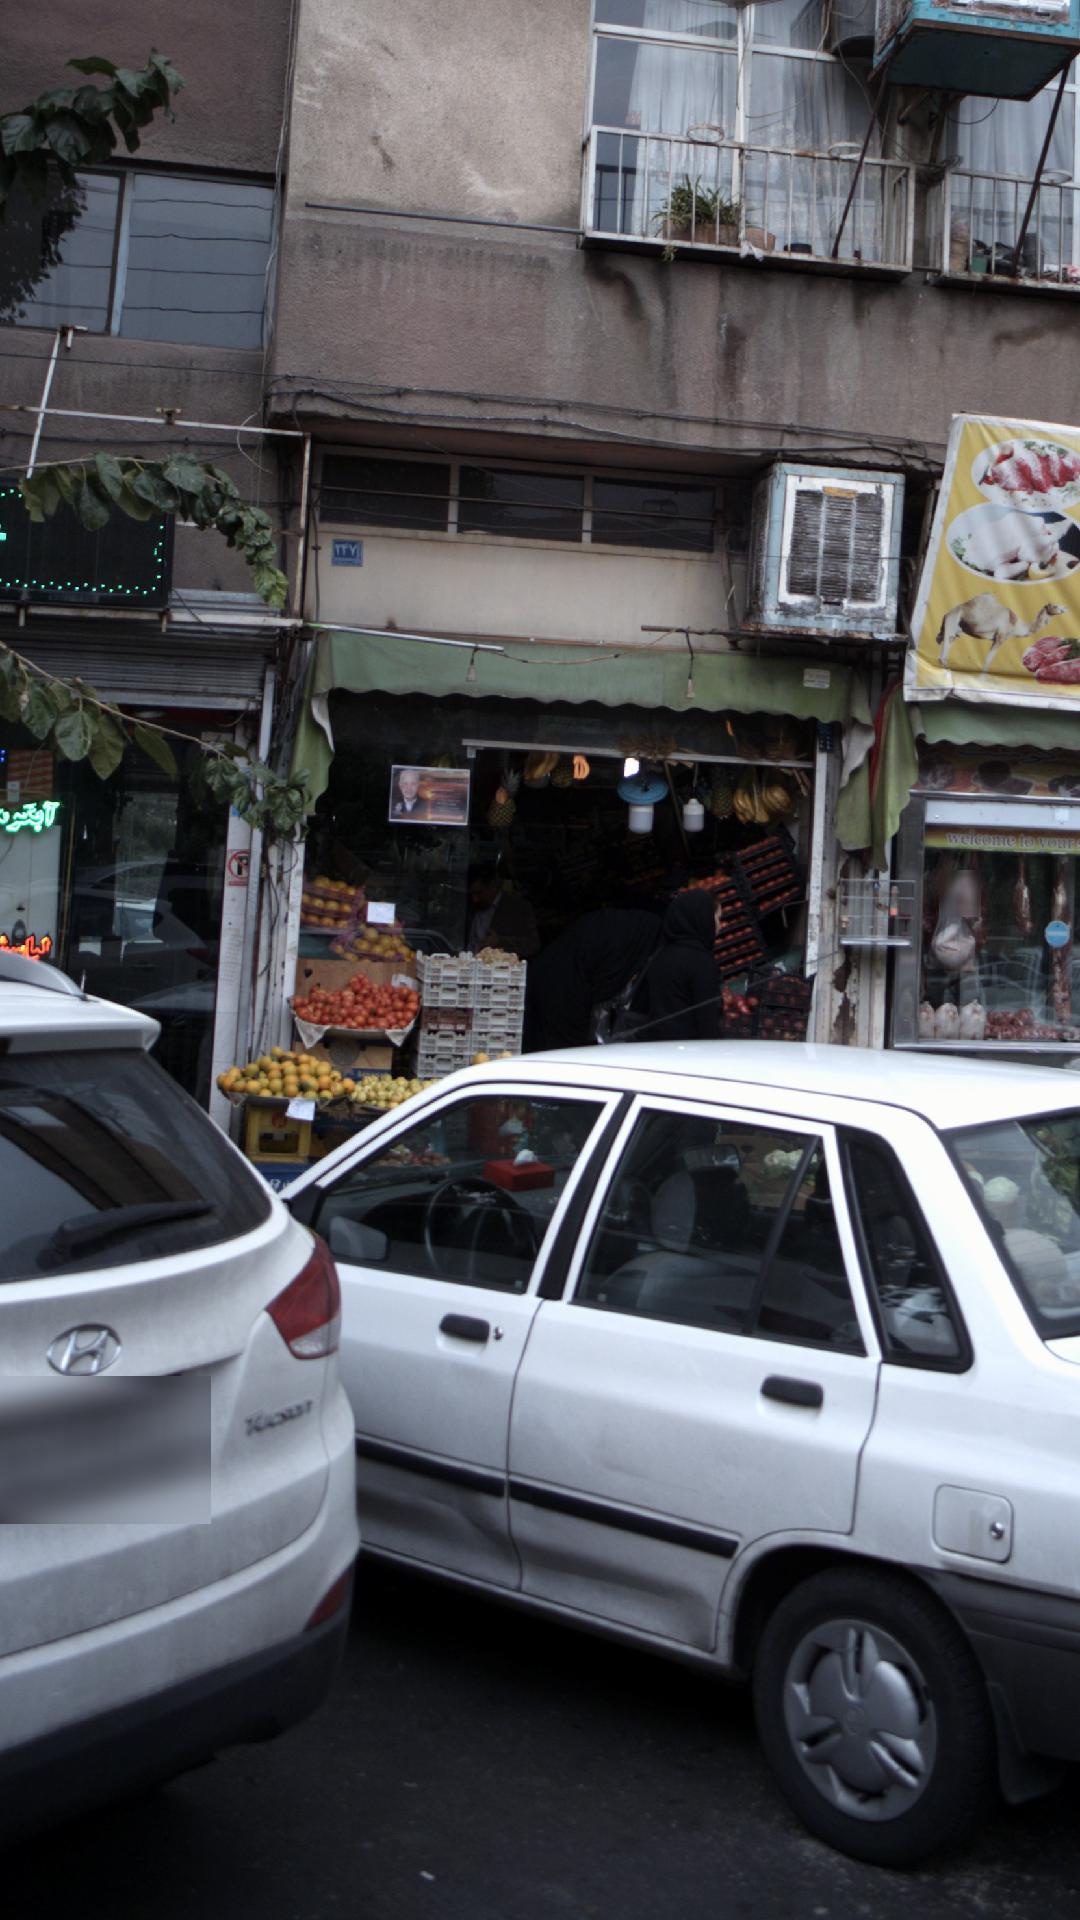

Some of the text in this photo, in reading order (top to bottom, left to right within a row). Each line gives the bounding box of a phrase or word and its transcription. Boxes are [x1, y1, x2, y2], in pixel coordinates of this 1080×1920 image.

[945, 829, 1016, 848] welcome
[1020, 833, 1034, 848] to
[1038, 836, 1074, 849] your
